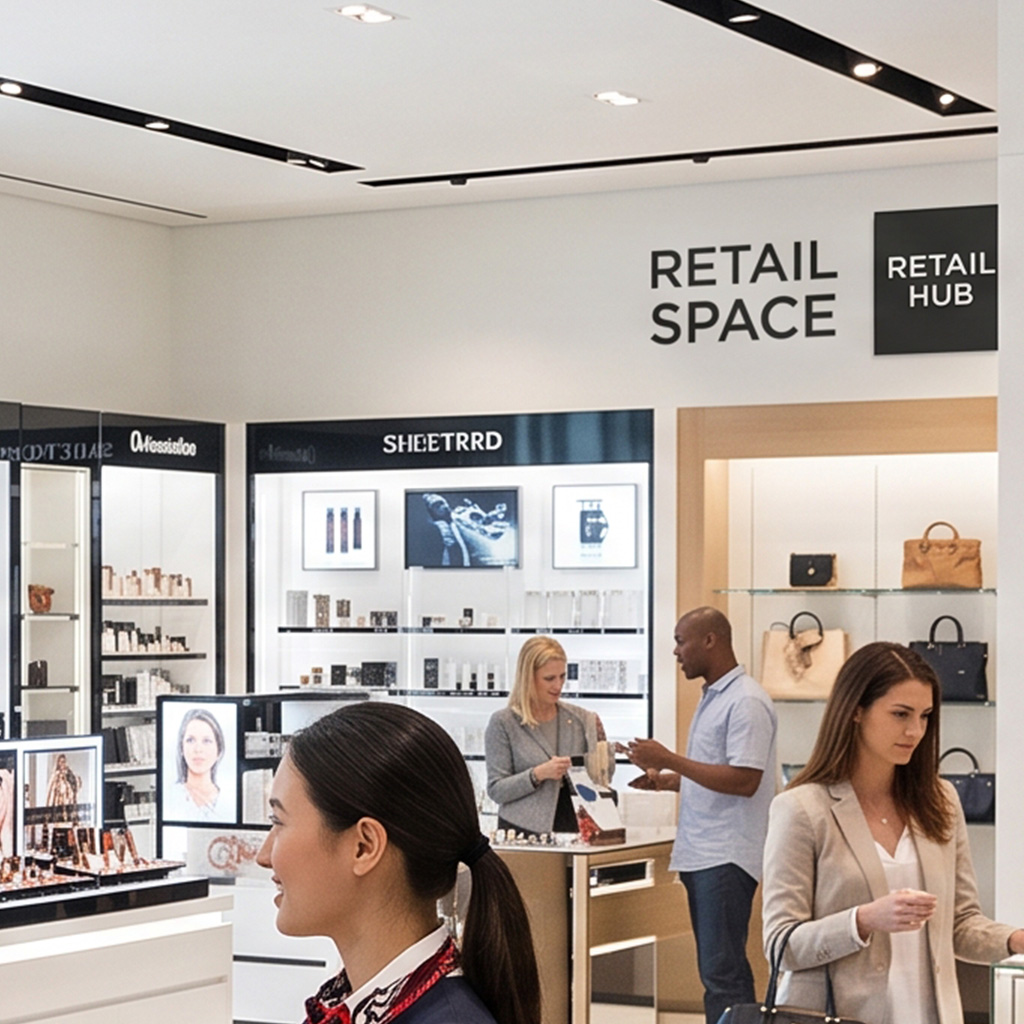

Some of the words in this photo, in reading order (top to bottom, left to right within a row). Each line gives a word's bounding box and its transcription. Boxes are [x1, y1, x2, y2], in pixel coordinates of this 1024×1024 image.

[650, 240, 838, 289] RETAIL
[887, 252, 996, 279] RETAIL
[908, 283, 974, 308] HUB
[650, 293, 836, 345] SPACE
